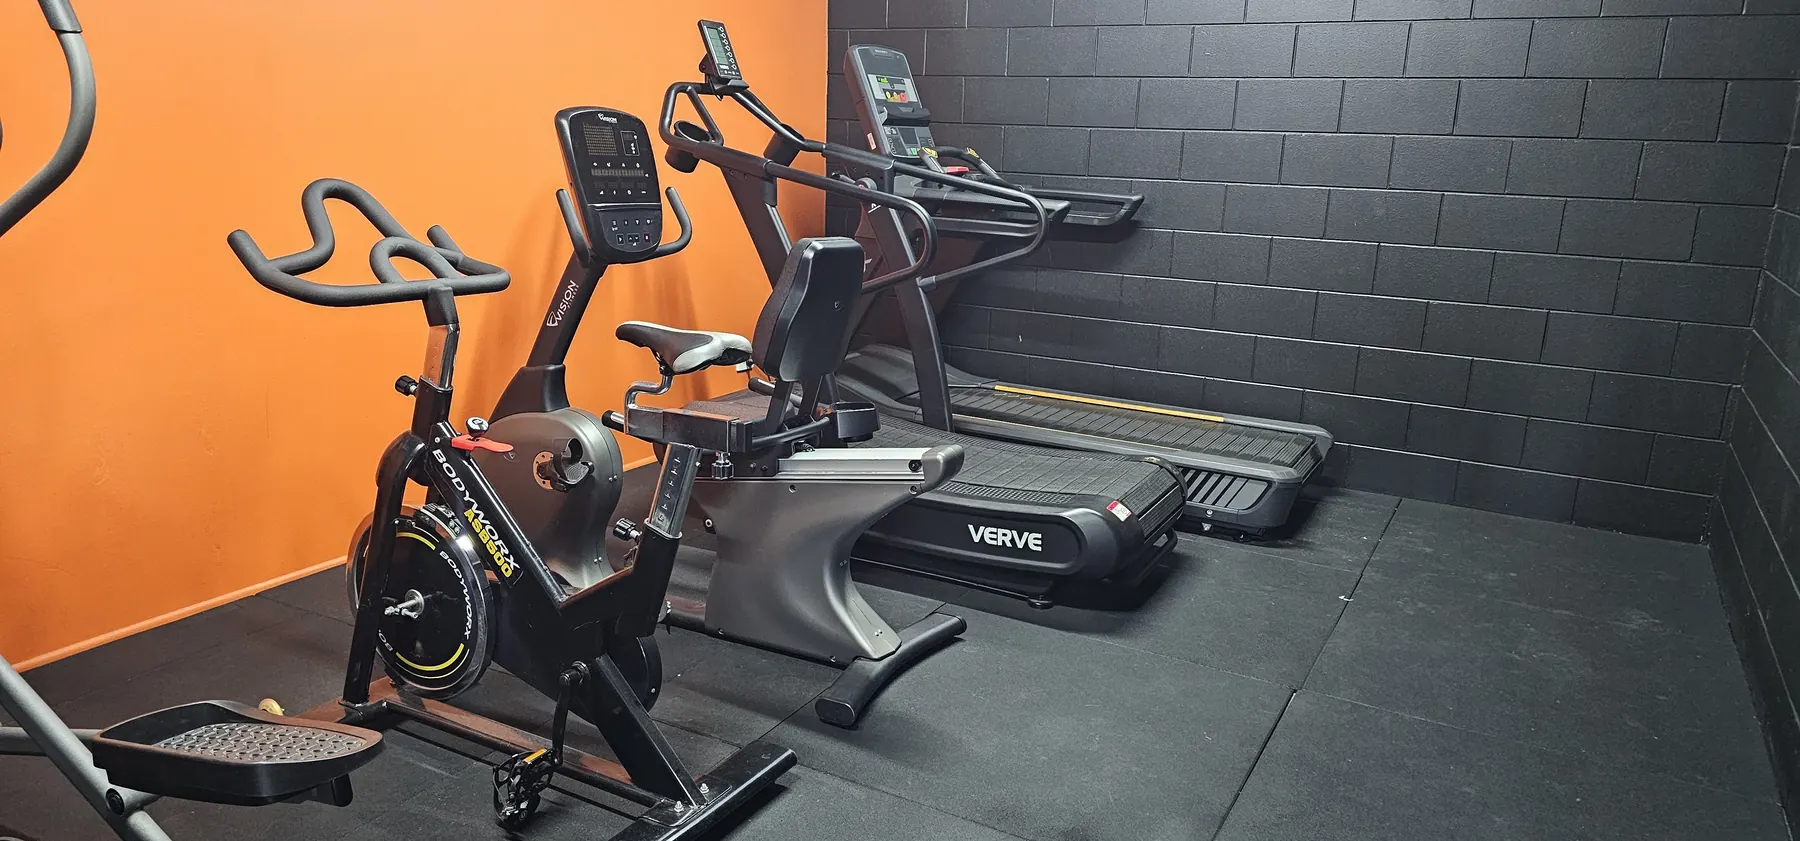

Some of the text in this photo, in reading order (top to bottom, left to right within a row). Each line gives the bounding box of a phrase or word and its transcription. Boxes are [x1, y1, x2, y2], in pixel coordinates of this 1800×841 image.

[555, 280, 577, 321] VISION
[432, 449, 520, 571] BODYWORX
[464, 508, 513, 578] ASB500
[967, 524, 1042, 551] VERVE
[440, 550, 472, 640] BODYWORX
